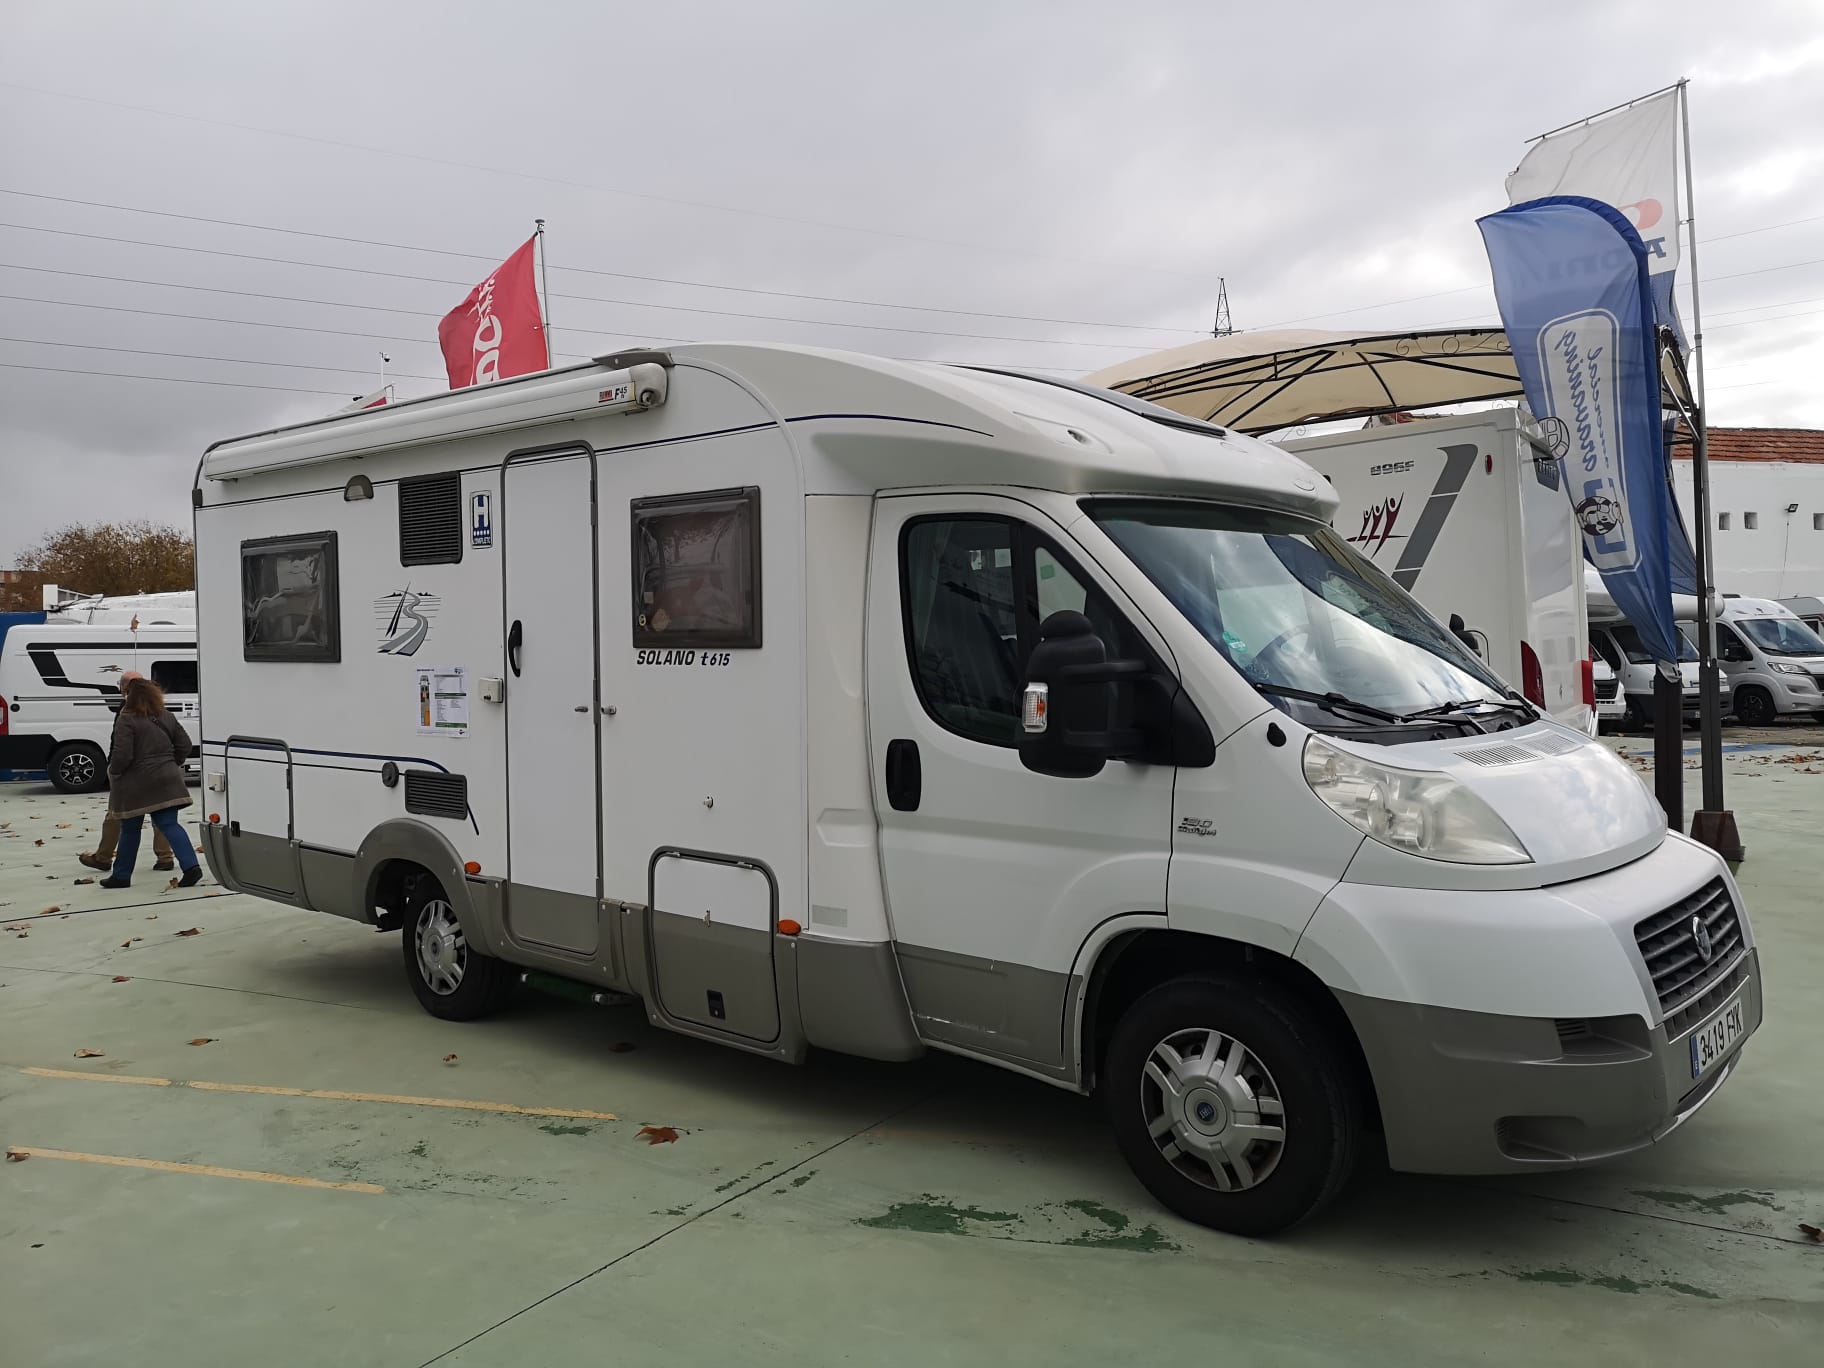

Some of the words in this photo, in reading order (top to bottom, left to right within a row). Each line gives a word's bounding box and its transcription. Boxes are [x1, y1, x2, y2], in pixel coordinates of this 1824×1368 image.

[636, 649, 696, 666] SOLANO
[700, 651, 731, 667] t615
[1700, 1020, 1725, 1067] 3419
